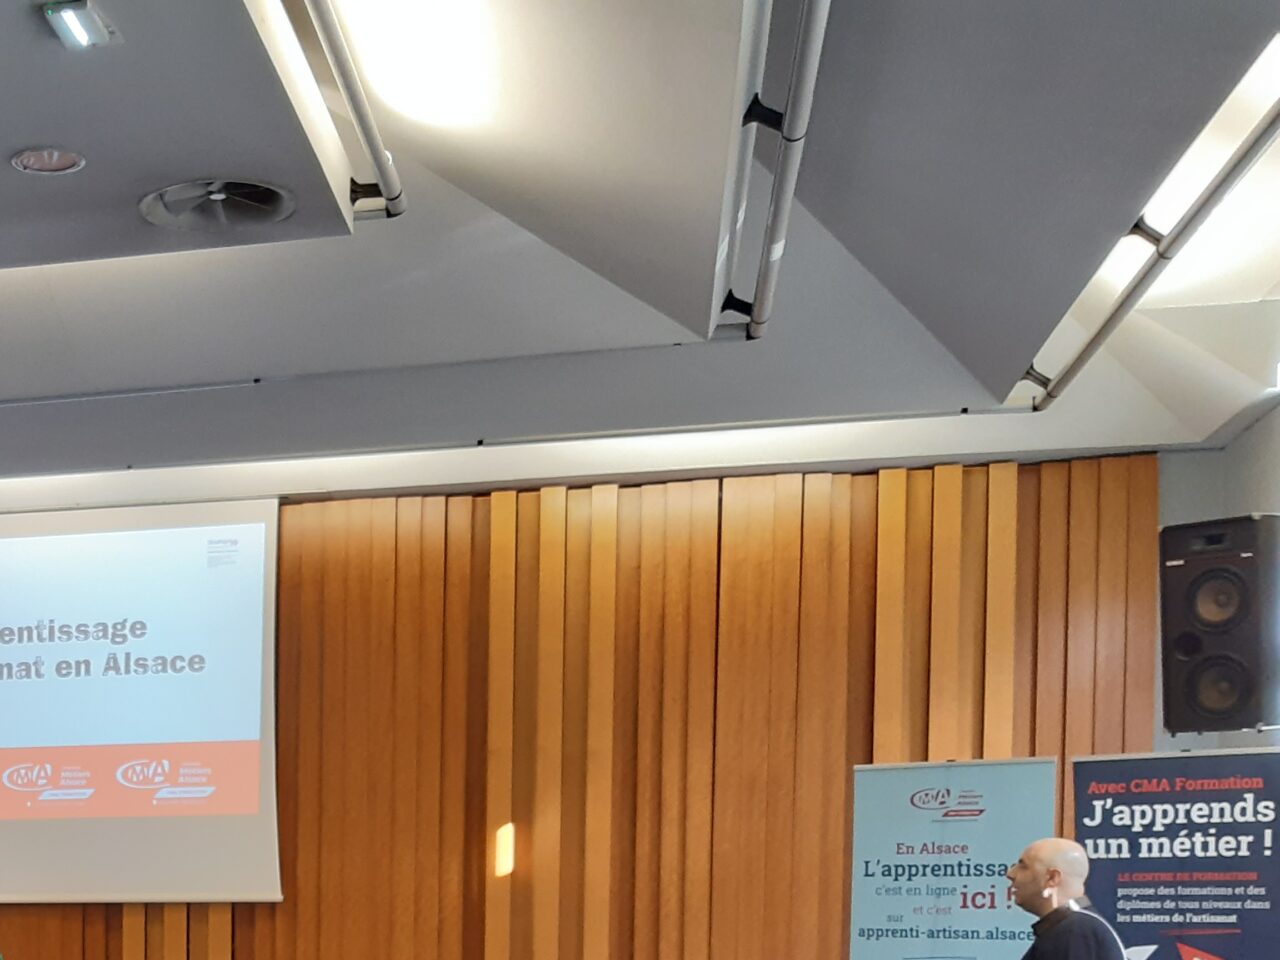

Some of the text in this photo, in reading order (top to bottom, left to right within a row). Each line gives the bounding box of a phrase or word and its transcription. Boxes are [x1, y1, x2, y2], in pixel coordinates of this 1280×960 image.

[55, 657, 92, 678] en
[102, 652, 206, 677] Alsace
[1087, 774, 1264, 795] Avec CMA Formation
[1082, 793, 1276, 832] J'apprends
[895, 841, 969, 855] En Alsace
[1084, 828, 1273, 859] un métier !
[863, 858, 1016, 882] L'apprentissa
[875, 885, 902, 896] c'est
[906, 887, 922, 896] en
[926, 885, 957, 899] ligne
[960, 885, 997, 909] ici
[1117, 885, 1266, 897] propose des formations et des
[912, 905, 923, 915] et
[1163, 899, 1176, 909] de
[1201, 900, 1242, 909] niveaux
[1243, 899, 1271, 909] dans
[886, 914, 904, 922] sur
[1117, 913, 1131, 922] les
[1132, 913, 1170, 922] métiers
[1171, 913, 1185, 922] de
[858, 926, 1034, 941] apprenti-artisan.alsace
